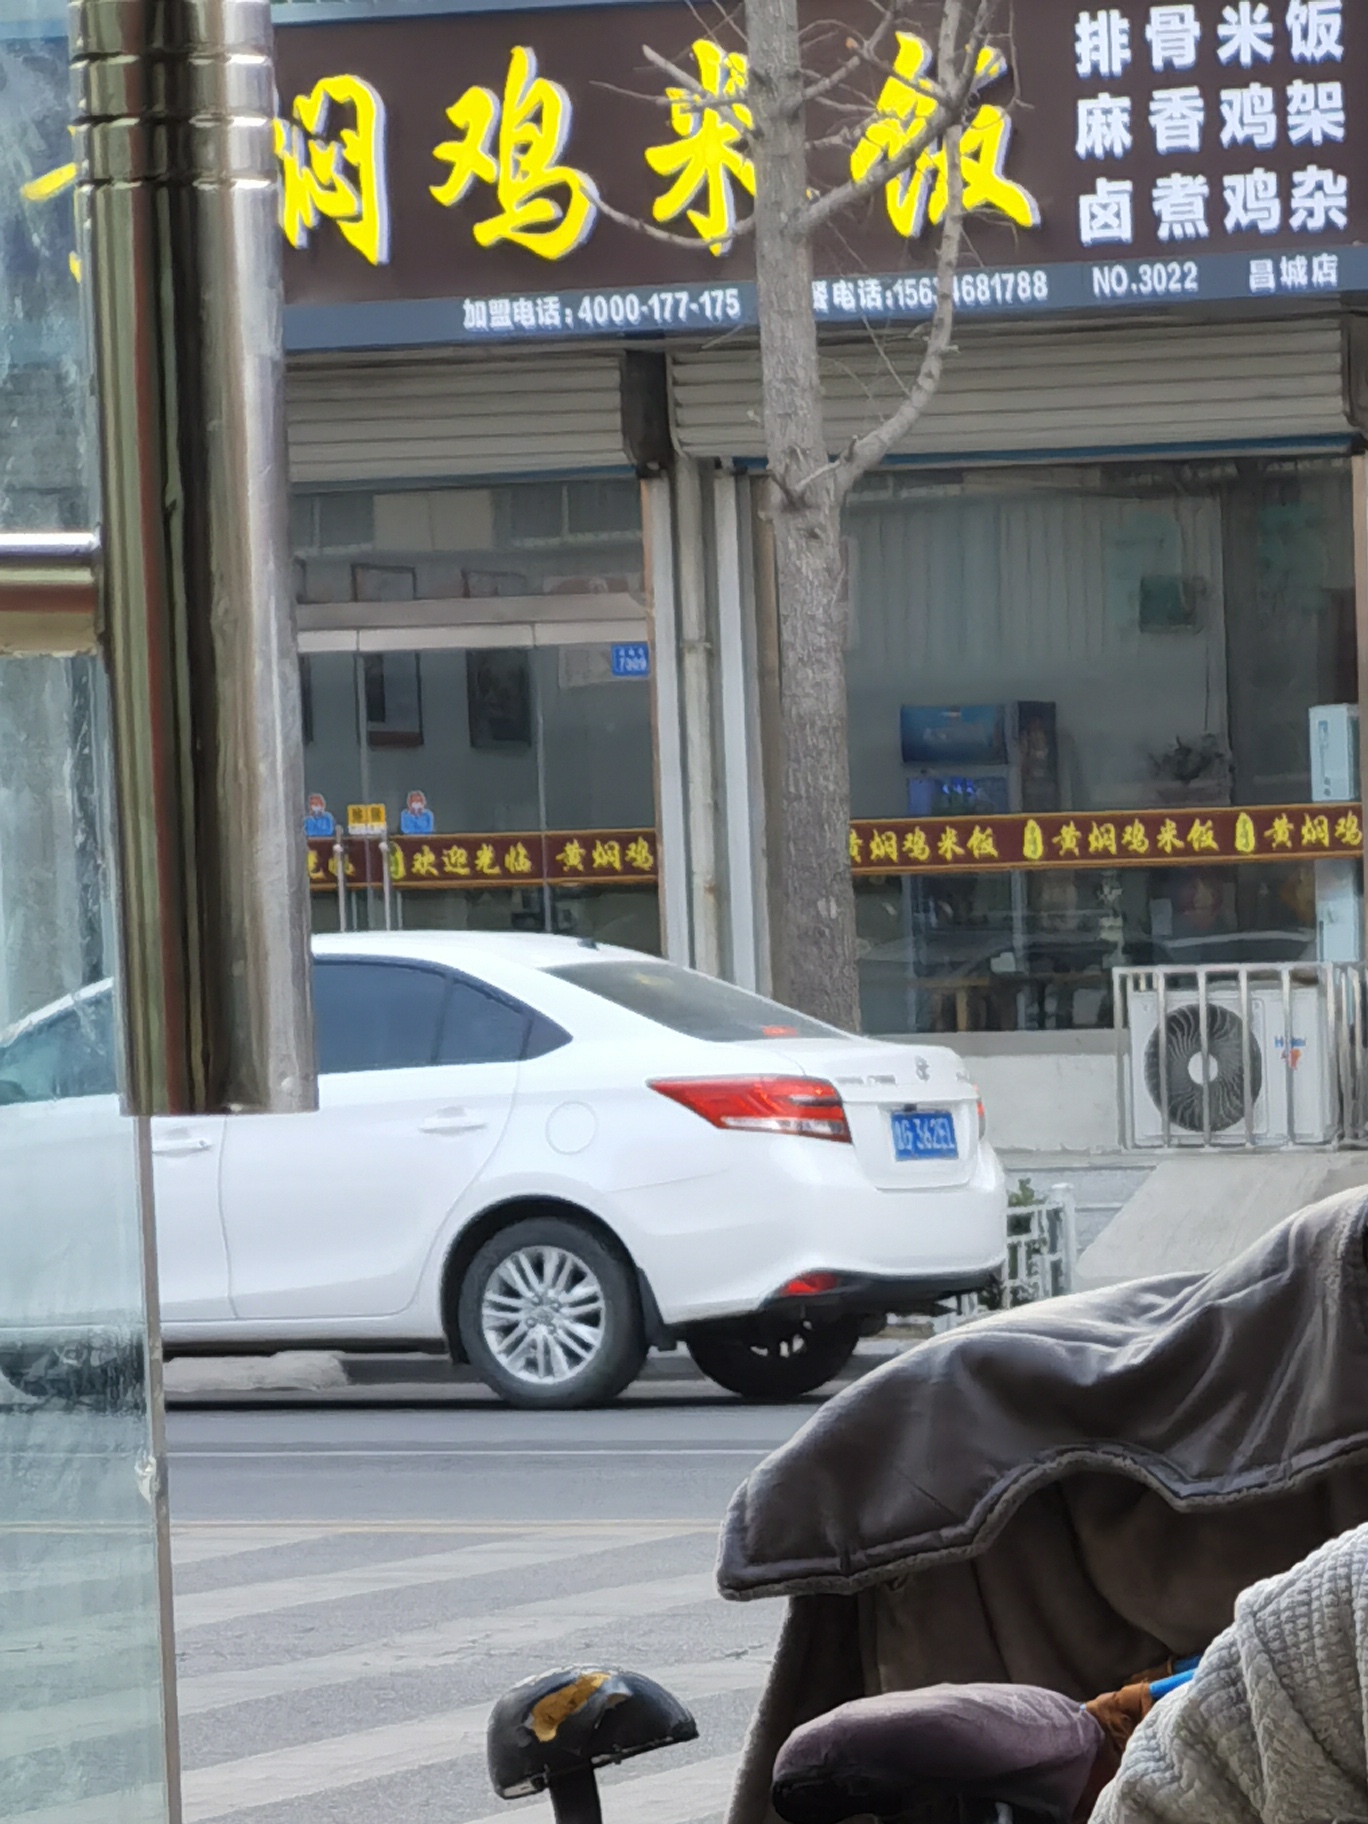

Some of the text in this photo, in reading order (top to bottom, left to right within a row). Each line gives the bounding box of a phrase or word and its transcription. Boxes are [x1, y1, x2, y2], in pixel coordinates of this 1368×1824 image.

[1075, 2, 1344, 78] 排骨米饭
[1074, 80, 1346, 160] 麻香鸡架
[20, 32, 1043, 284] 焖鸡米饭
[1078, 165, 1348, 247] 卤煮鸡杂
[1092, 261, 1199, 299] NO.3022
[1249, 252, 1339, 294] 昌城店
[411, 842, 532, 876] 欢迎光临
[1052, 817, 1219, 856] 黄焖鸡米饭
[1263, 810, 1363, 850] 黄焖鸡
